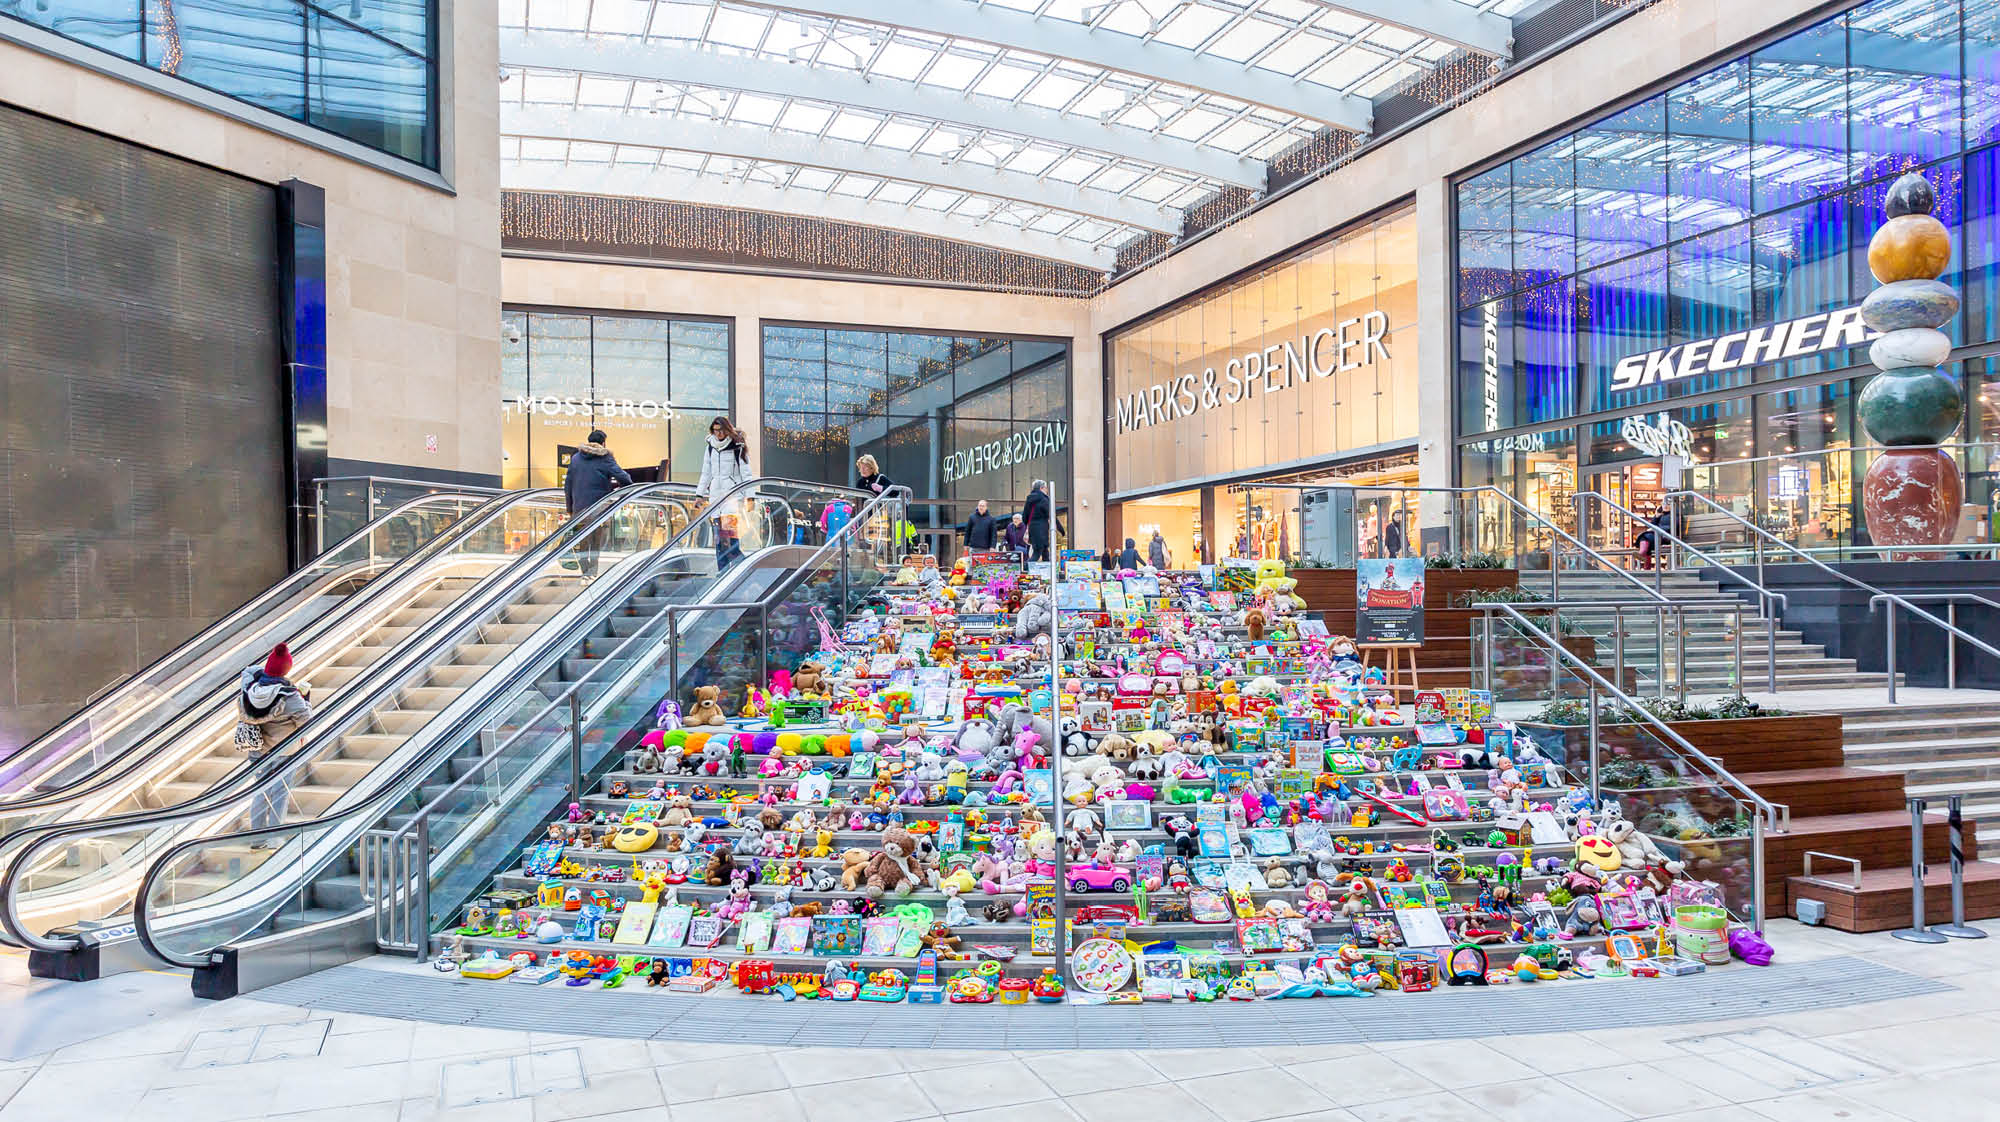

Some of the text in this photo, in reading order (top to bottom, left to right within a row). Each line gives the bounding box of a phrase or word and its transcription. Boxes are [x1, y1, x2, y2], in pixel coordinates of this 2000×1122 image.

[1116, 310, 1392, 434] MARKS & SPENCER
[1483, 295, 1498, 432] SKECHERS
[517, 395, 593, 417] MOSS
[1371, 596, 1407, 606] DONATION
